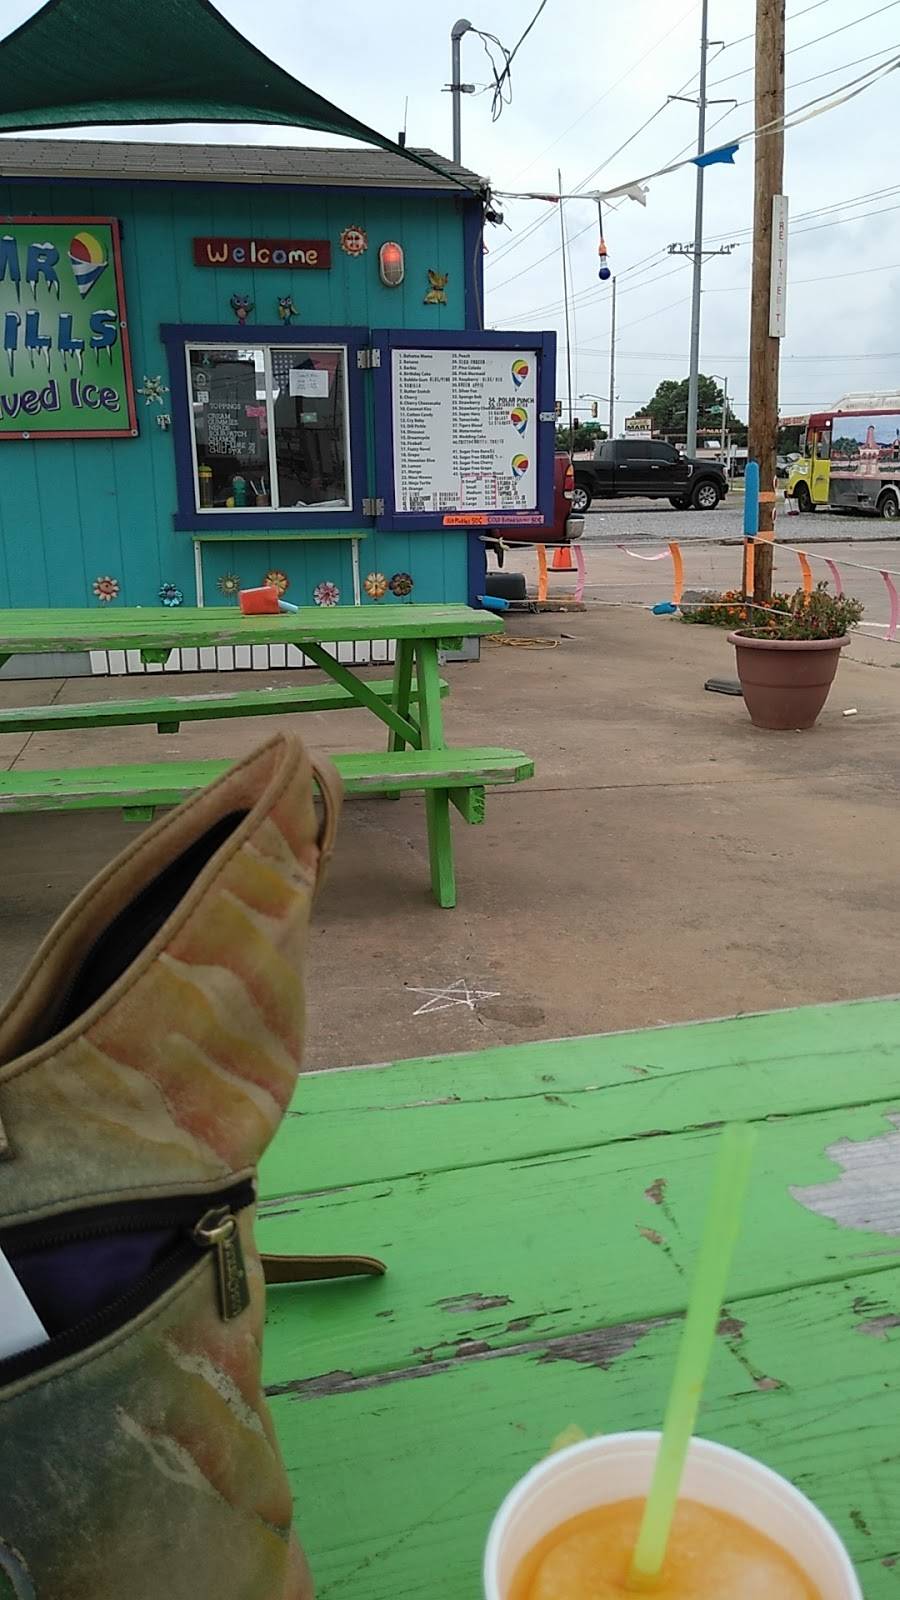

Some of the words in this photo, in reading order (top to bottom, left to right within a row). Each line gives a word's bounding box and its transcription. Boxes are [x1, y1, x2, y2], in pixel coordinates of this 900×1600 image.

[206, 241, 319, 265] Welcome
[0, 378, 61, 419] ved
[70, 377, 120, 412] Ice
